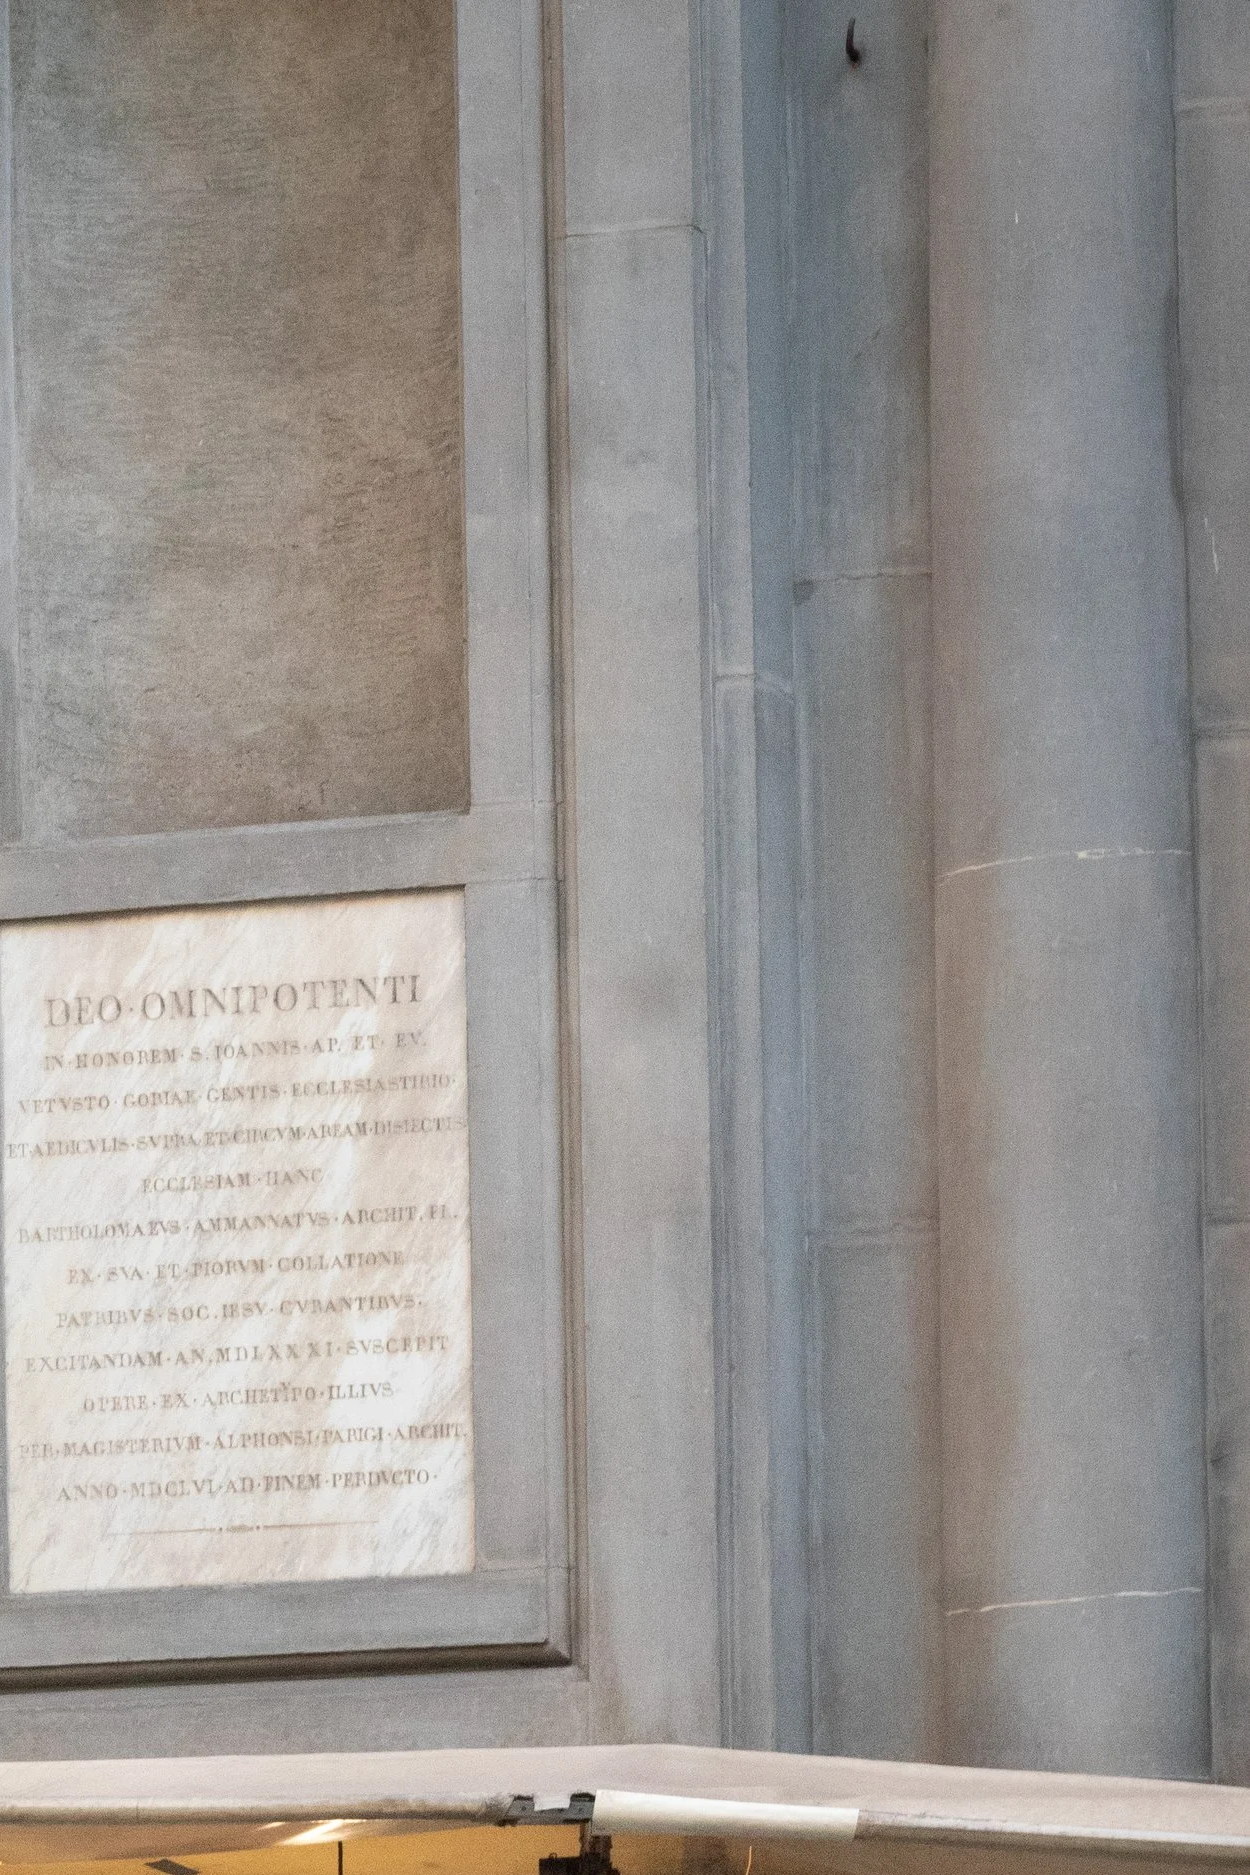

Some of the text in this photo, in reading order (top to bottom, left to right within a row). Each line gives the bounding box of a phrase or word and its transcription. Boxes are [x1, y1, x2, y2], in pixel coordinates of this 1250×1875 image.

[44, 974, 421, 1028] DEO OMNIPOTENTI
[44, 1055, 65, 1073] IN
[75, 1049, 178, 1070] HONOREM
[214, 1039, 302, 1060] IOANNIS
[352, 1034, 381, 1051] ET
[17, 1084, 280, 1115] VETVSTO GENTIS
[7, 1143, 27, 1159] ET
[142, 1168, 323, 1193] ECCLESIAM HANC
[66, 1267, 94, 1285] EX
[156, 1262, 181, 1279] ET
[277, 1250, 405, 1273] COLLATIONE
[160, 1391, 190, 1410] EX
[327, 1382, 395, 1400] ILLIVS
[58, 1483, 118, 1501] ANNO
[225, 1475, 255, 1494] AD
